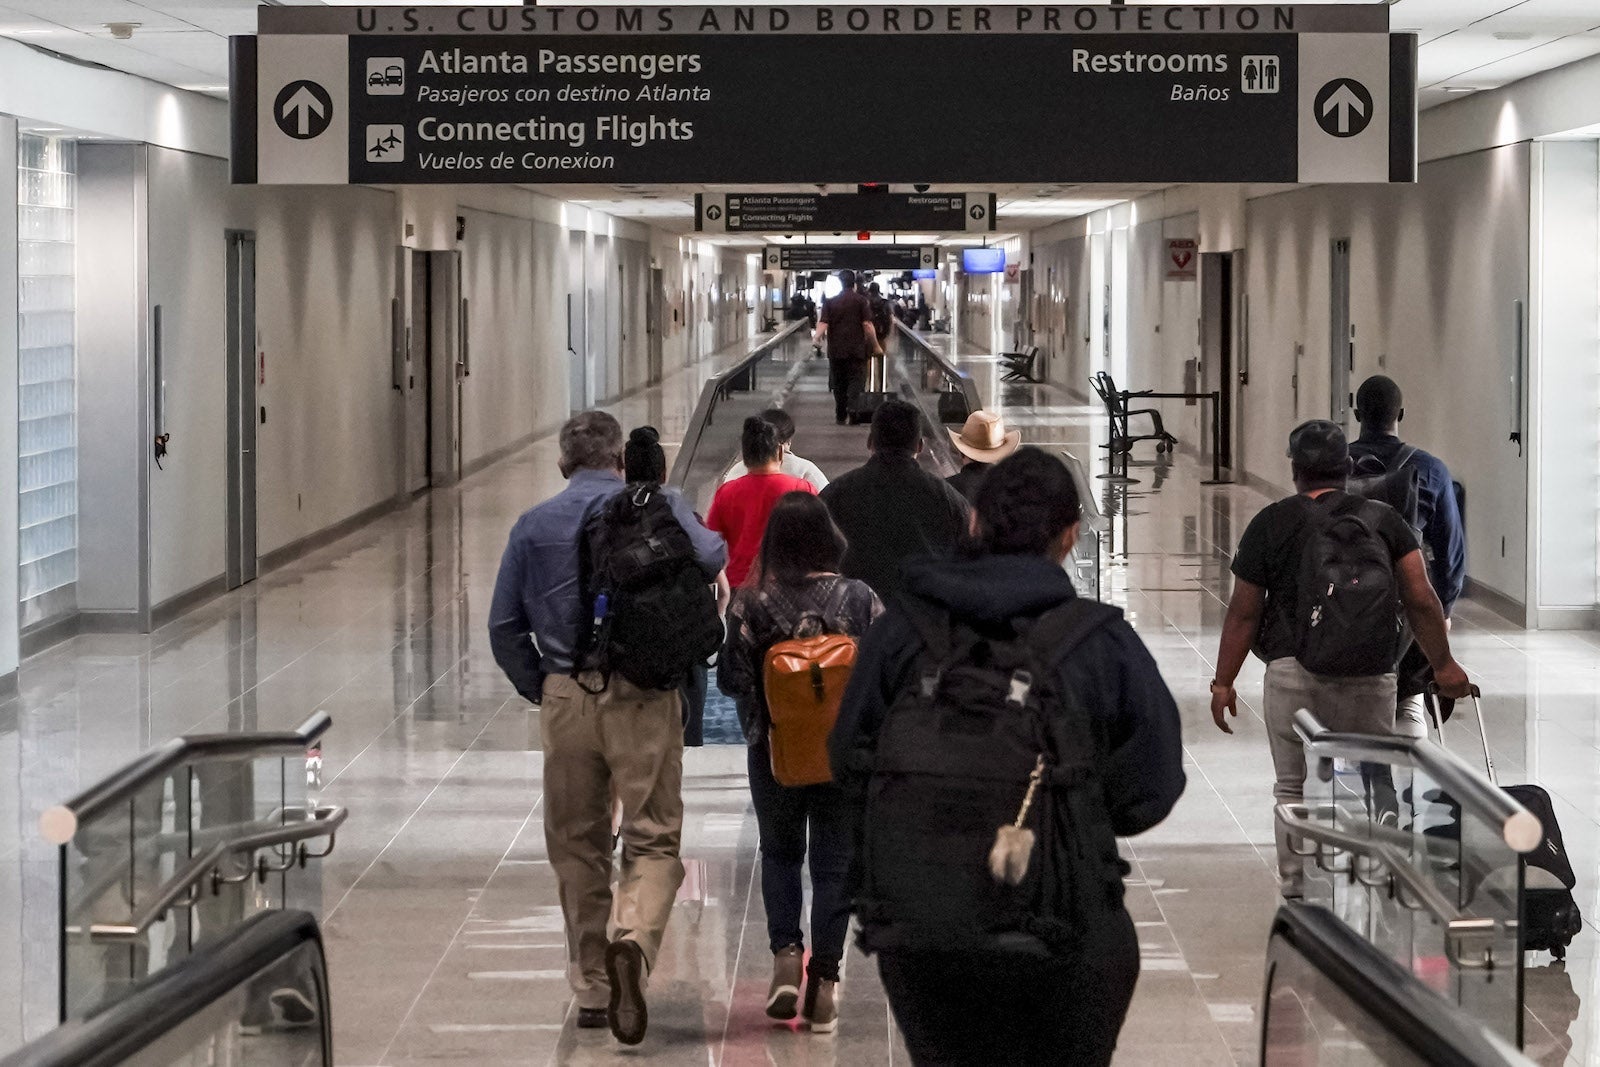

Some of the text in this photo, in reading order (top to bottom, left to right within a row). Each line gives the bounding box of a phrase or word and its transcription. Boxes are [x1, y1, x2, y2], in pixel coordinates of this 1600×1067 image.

[357, 8, 1294, 32] U.S. CUSTOMS AND BORDER PROTECTION
[418, 48, 702, 79] Atlanta Passengers
[1072, 48, 1228, 73] Restrooms
[418, 84, 711, 106] Pasajeros con destino Atlanta
[1170, 84, 1230, 102] Baños
[418, 114, 694, 145] Connecting Flights
[419, 151, 615, 170] Vuelos de Conexion
[773, 197, 816, 206] Passengers
[742, 213, 813, 222] Connecting Flights
[1169, 240, 1195, 249] AED
